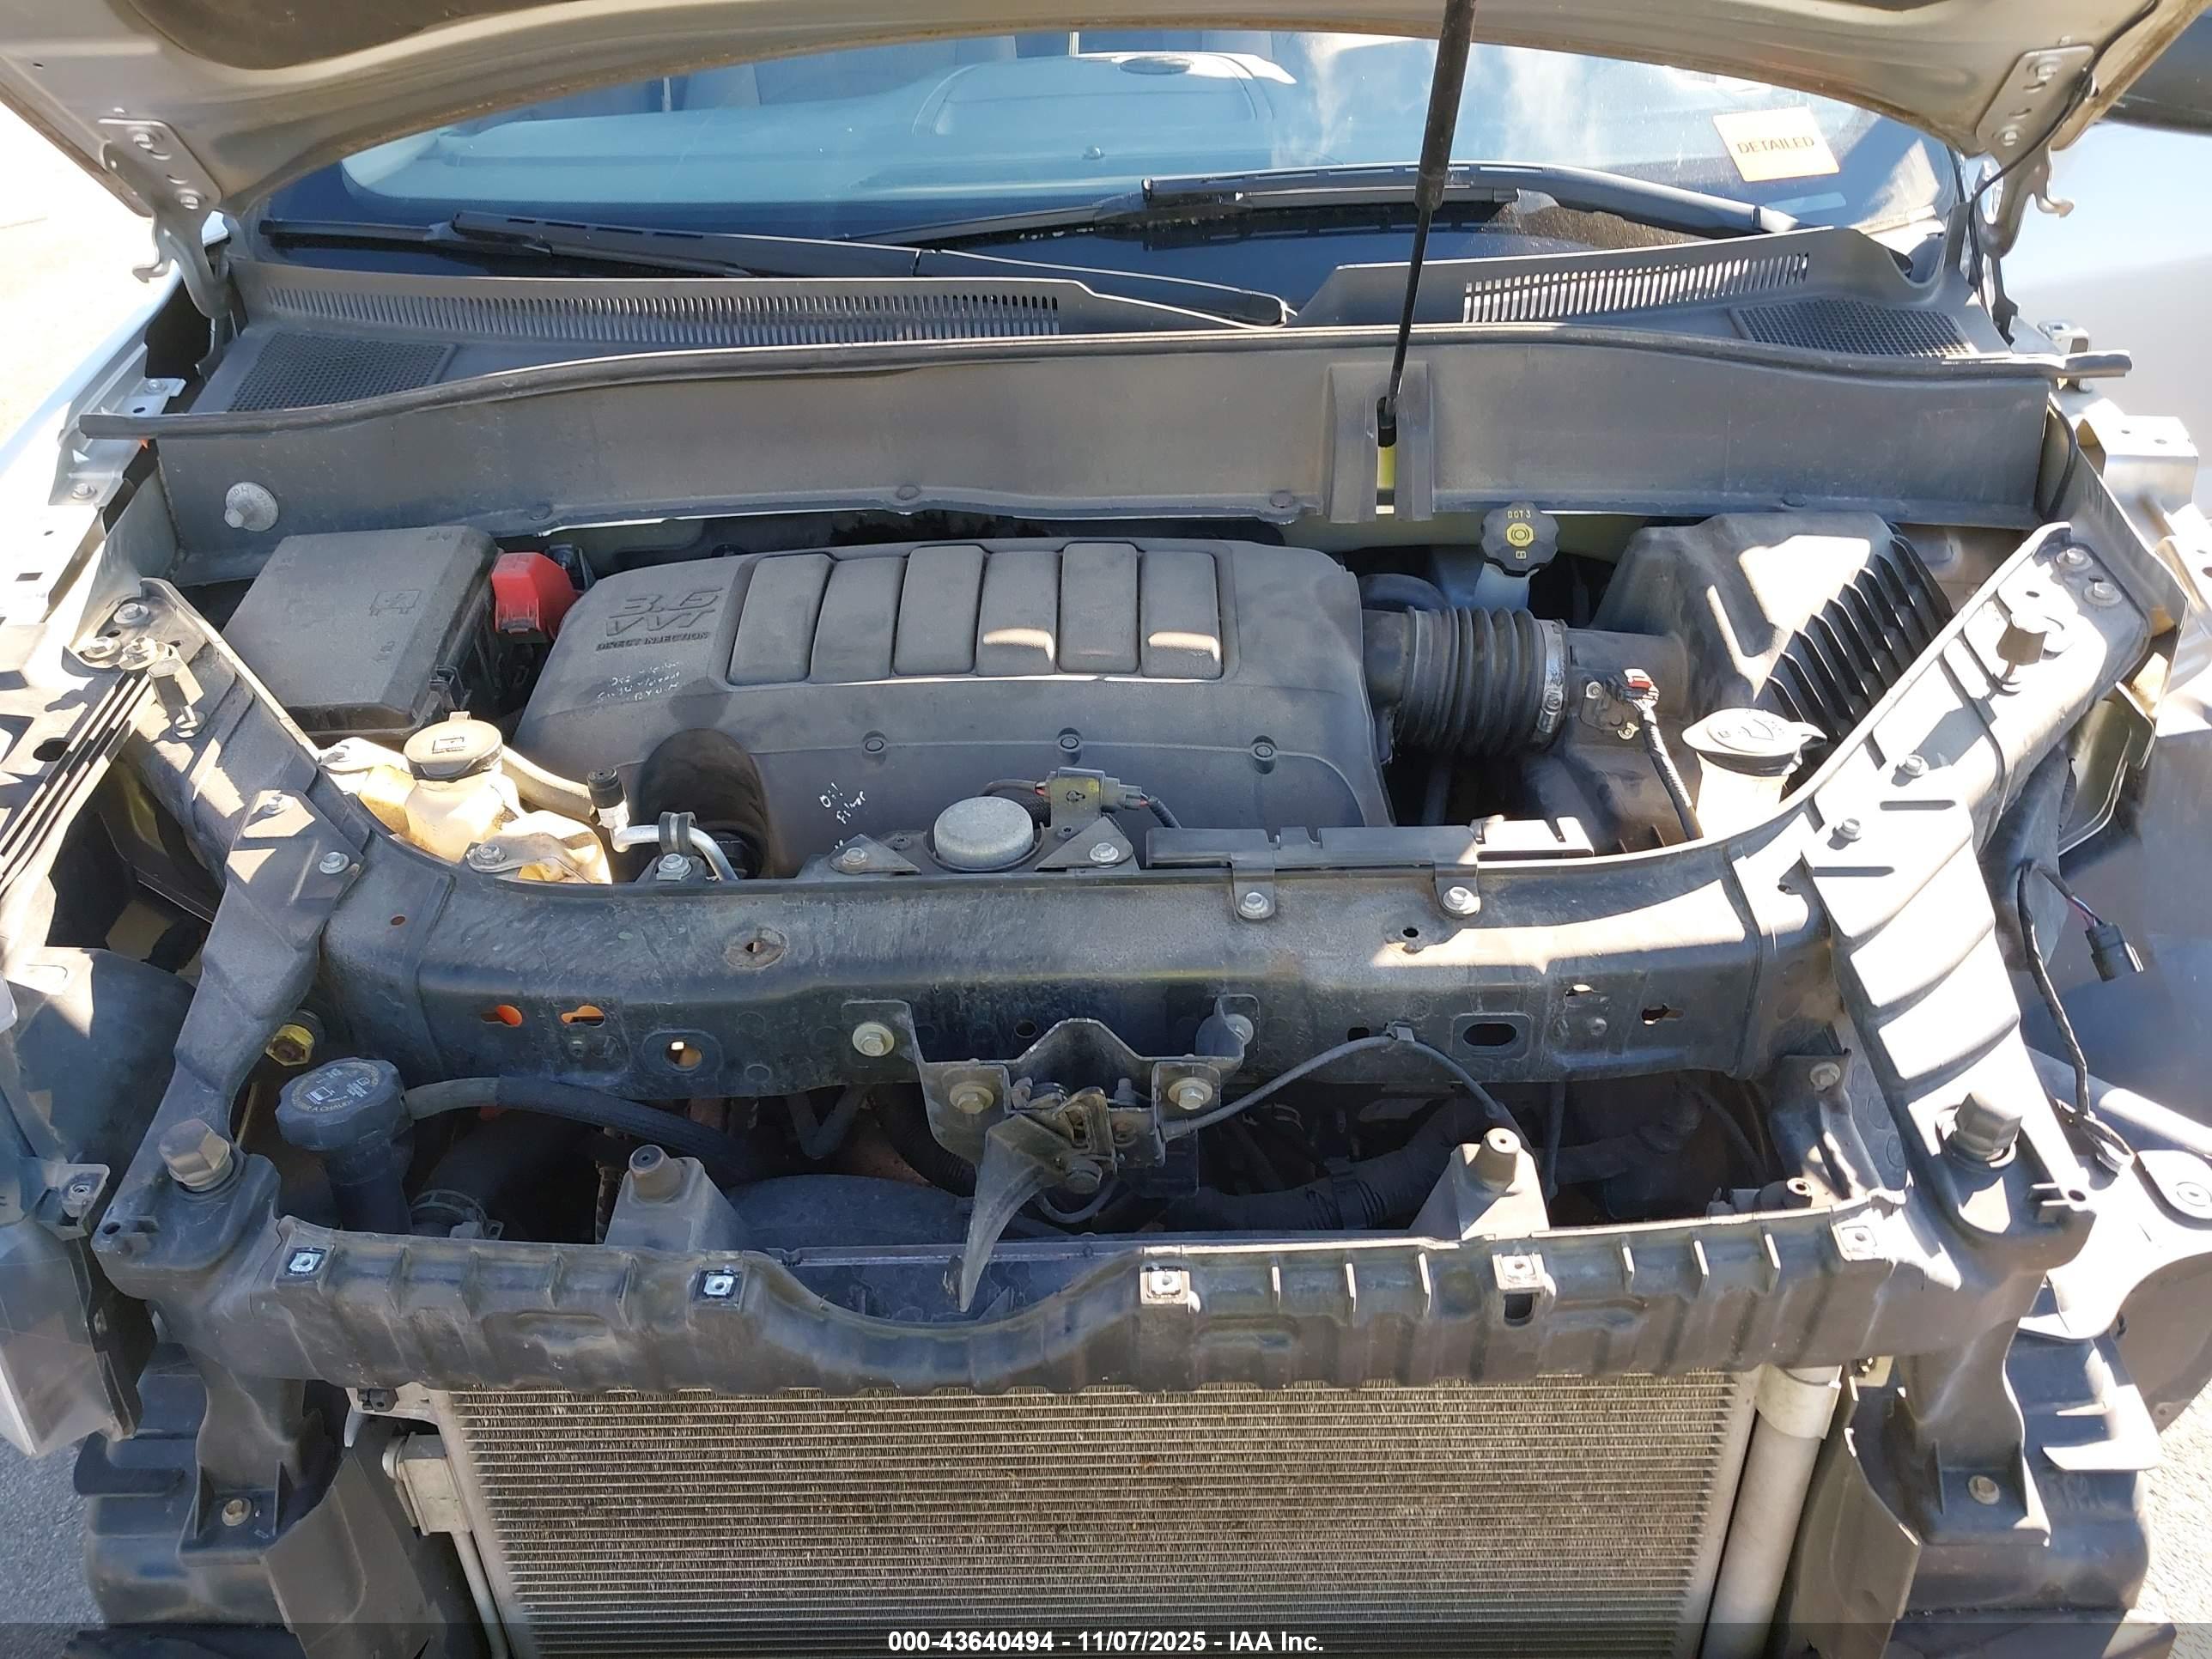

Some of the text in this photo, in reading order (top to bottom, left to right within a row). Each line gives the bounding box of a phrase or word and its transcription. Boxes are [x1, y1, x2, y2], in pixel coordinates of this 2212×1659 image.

[1737, 137, 1814, 154] DETAILED
[1507, 509, 1531, 519] DOT 3
[596, 631, 710, 652] DIRECT INJECTION
